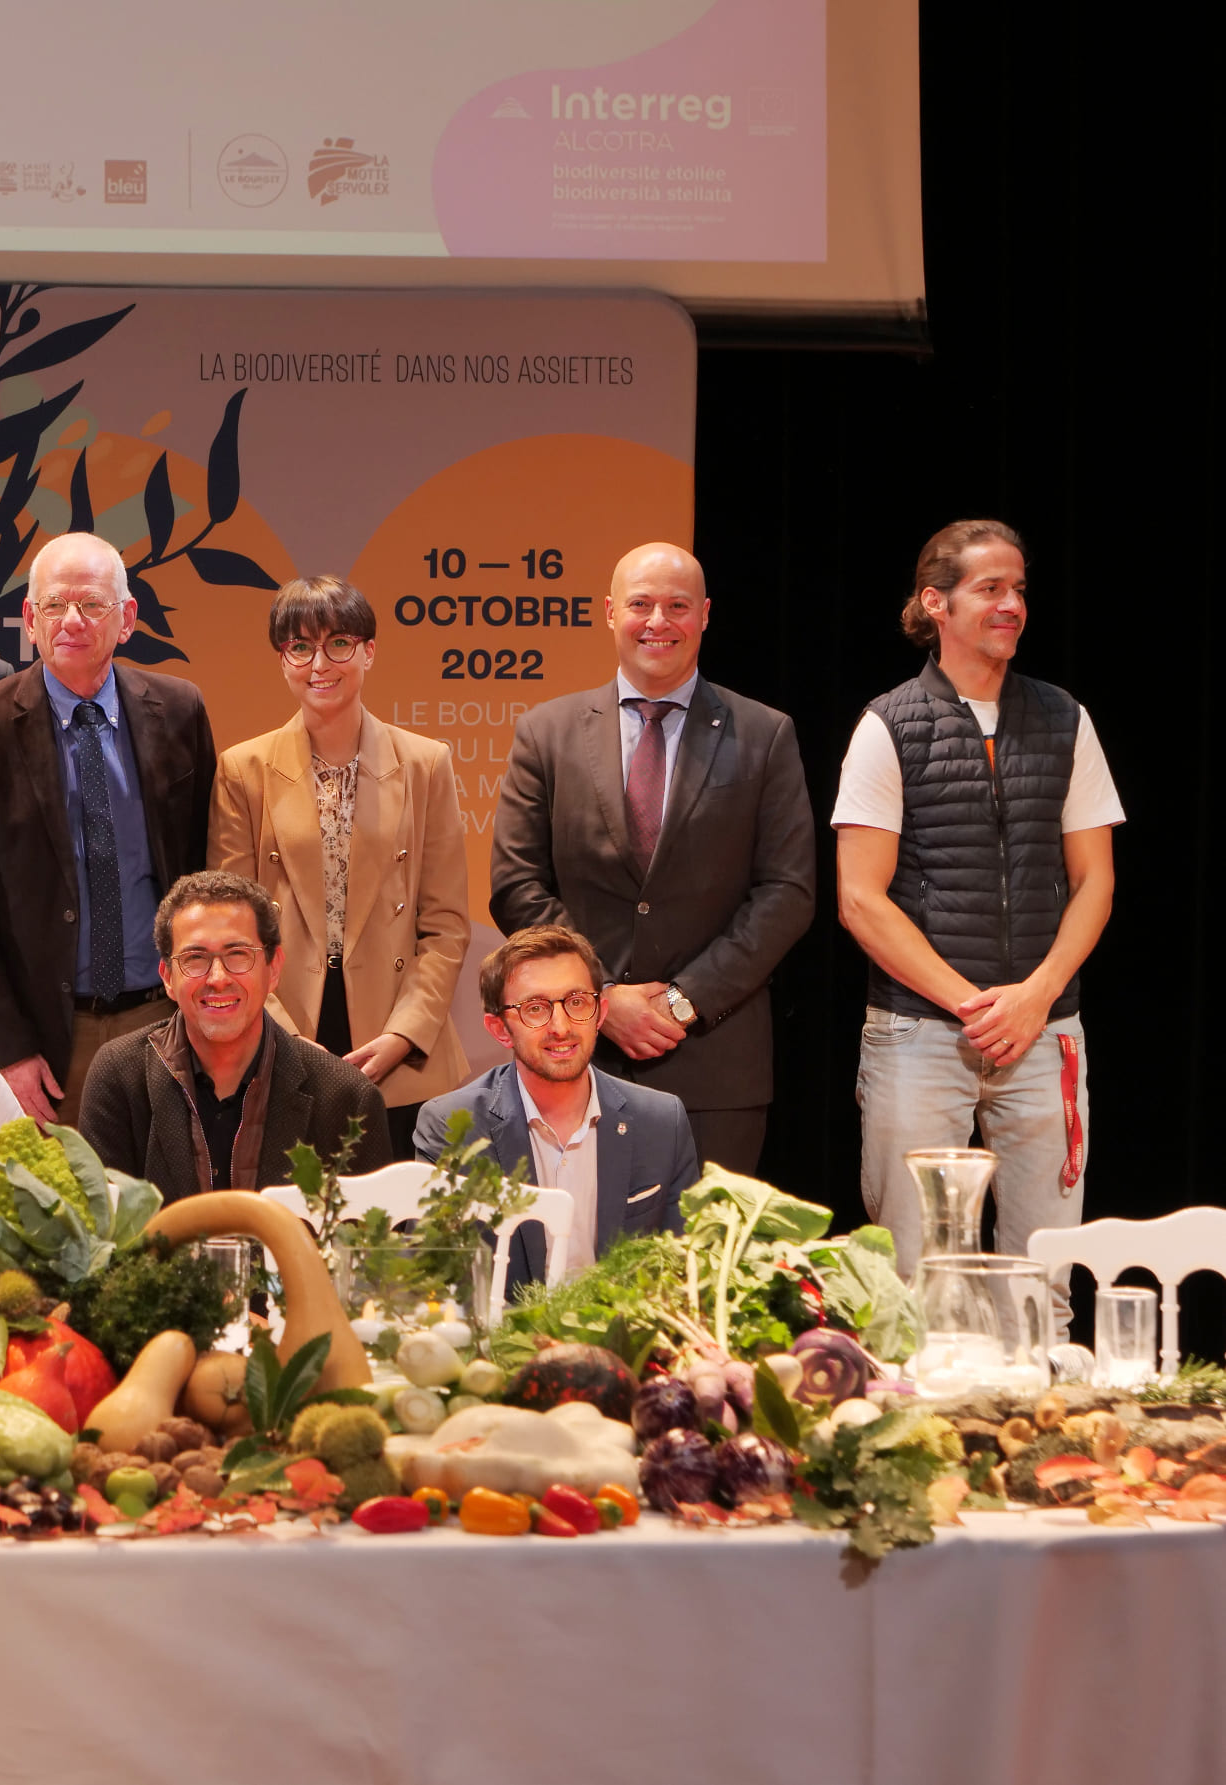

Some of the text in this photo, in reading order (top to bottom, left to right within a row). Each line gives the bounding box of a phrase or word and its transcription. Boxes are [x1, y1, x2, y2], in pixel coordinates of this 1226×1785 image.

[551, 84, 732, 130] Interreg
[553, 130, 675, 152] ALCOTRA
[374, 154, 390, 167] LA
[552, 162, 661, 180] biodiversité
[346, 168, 390, 181] MOTTE
[107, 178, 144, 195] bleu
[326, 182, 390, 195] SERVOLEX
[666, 185, 732, 203] stellata
[199, 348, 634, 386] LA BIODIVERSITÉ DANS NOS ASSIETTES
[423, 548, 466, 579] 10
[521, 549, 564, 580] 16
[394, 595, 593, 627] OCTOBRE
[441, 649, 544, 680] 2022
[393, 701, 530, 726] LE BOUR
